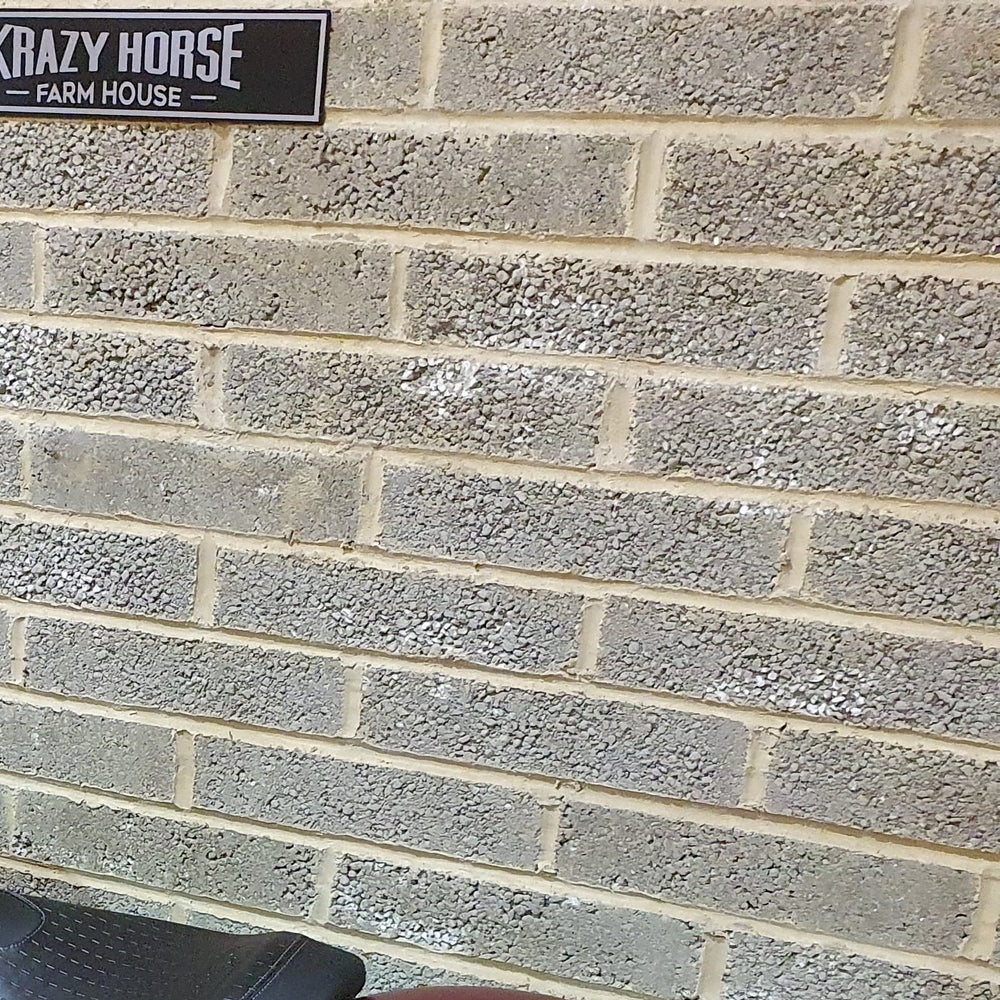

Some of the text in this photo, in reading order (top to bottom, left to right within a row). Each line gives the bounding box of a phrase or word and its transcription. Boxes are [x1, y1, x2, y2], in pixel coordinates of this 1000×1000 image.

[118, 22, 244, 90] HORSE
[36, 80, 182, 107] FARM HOUSE
